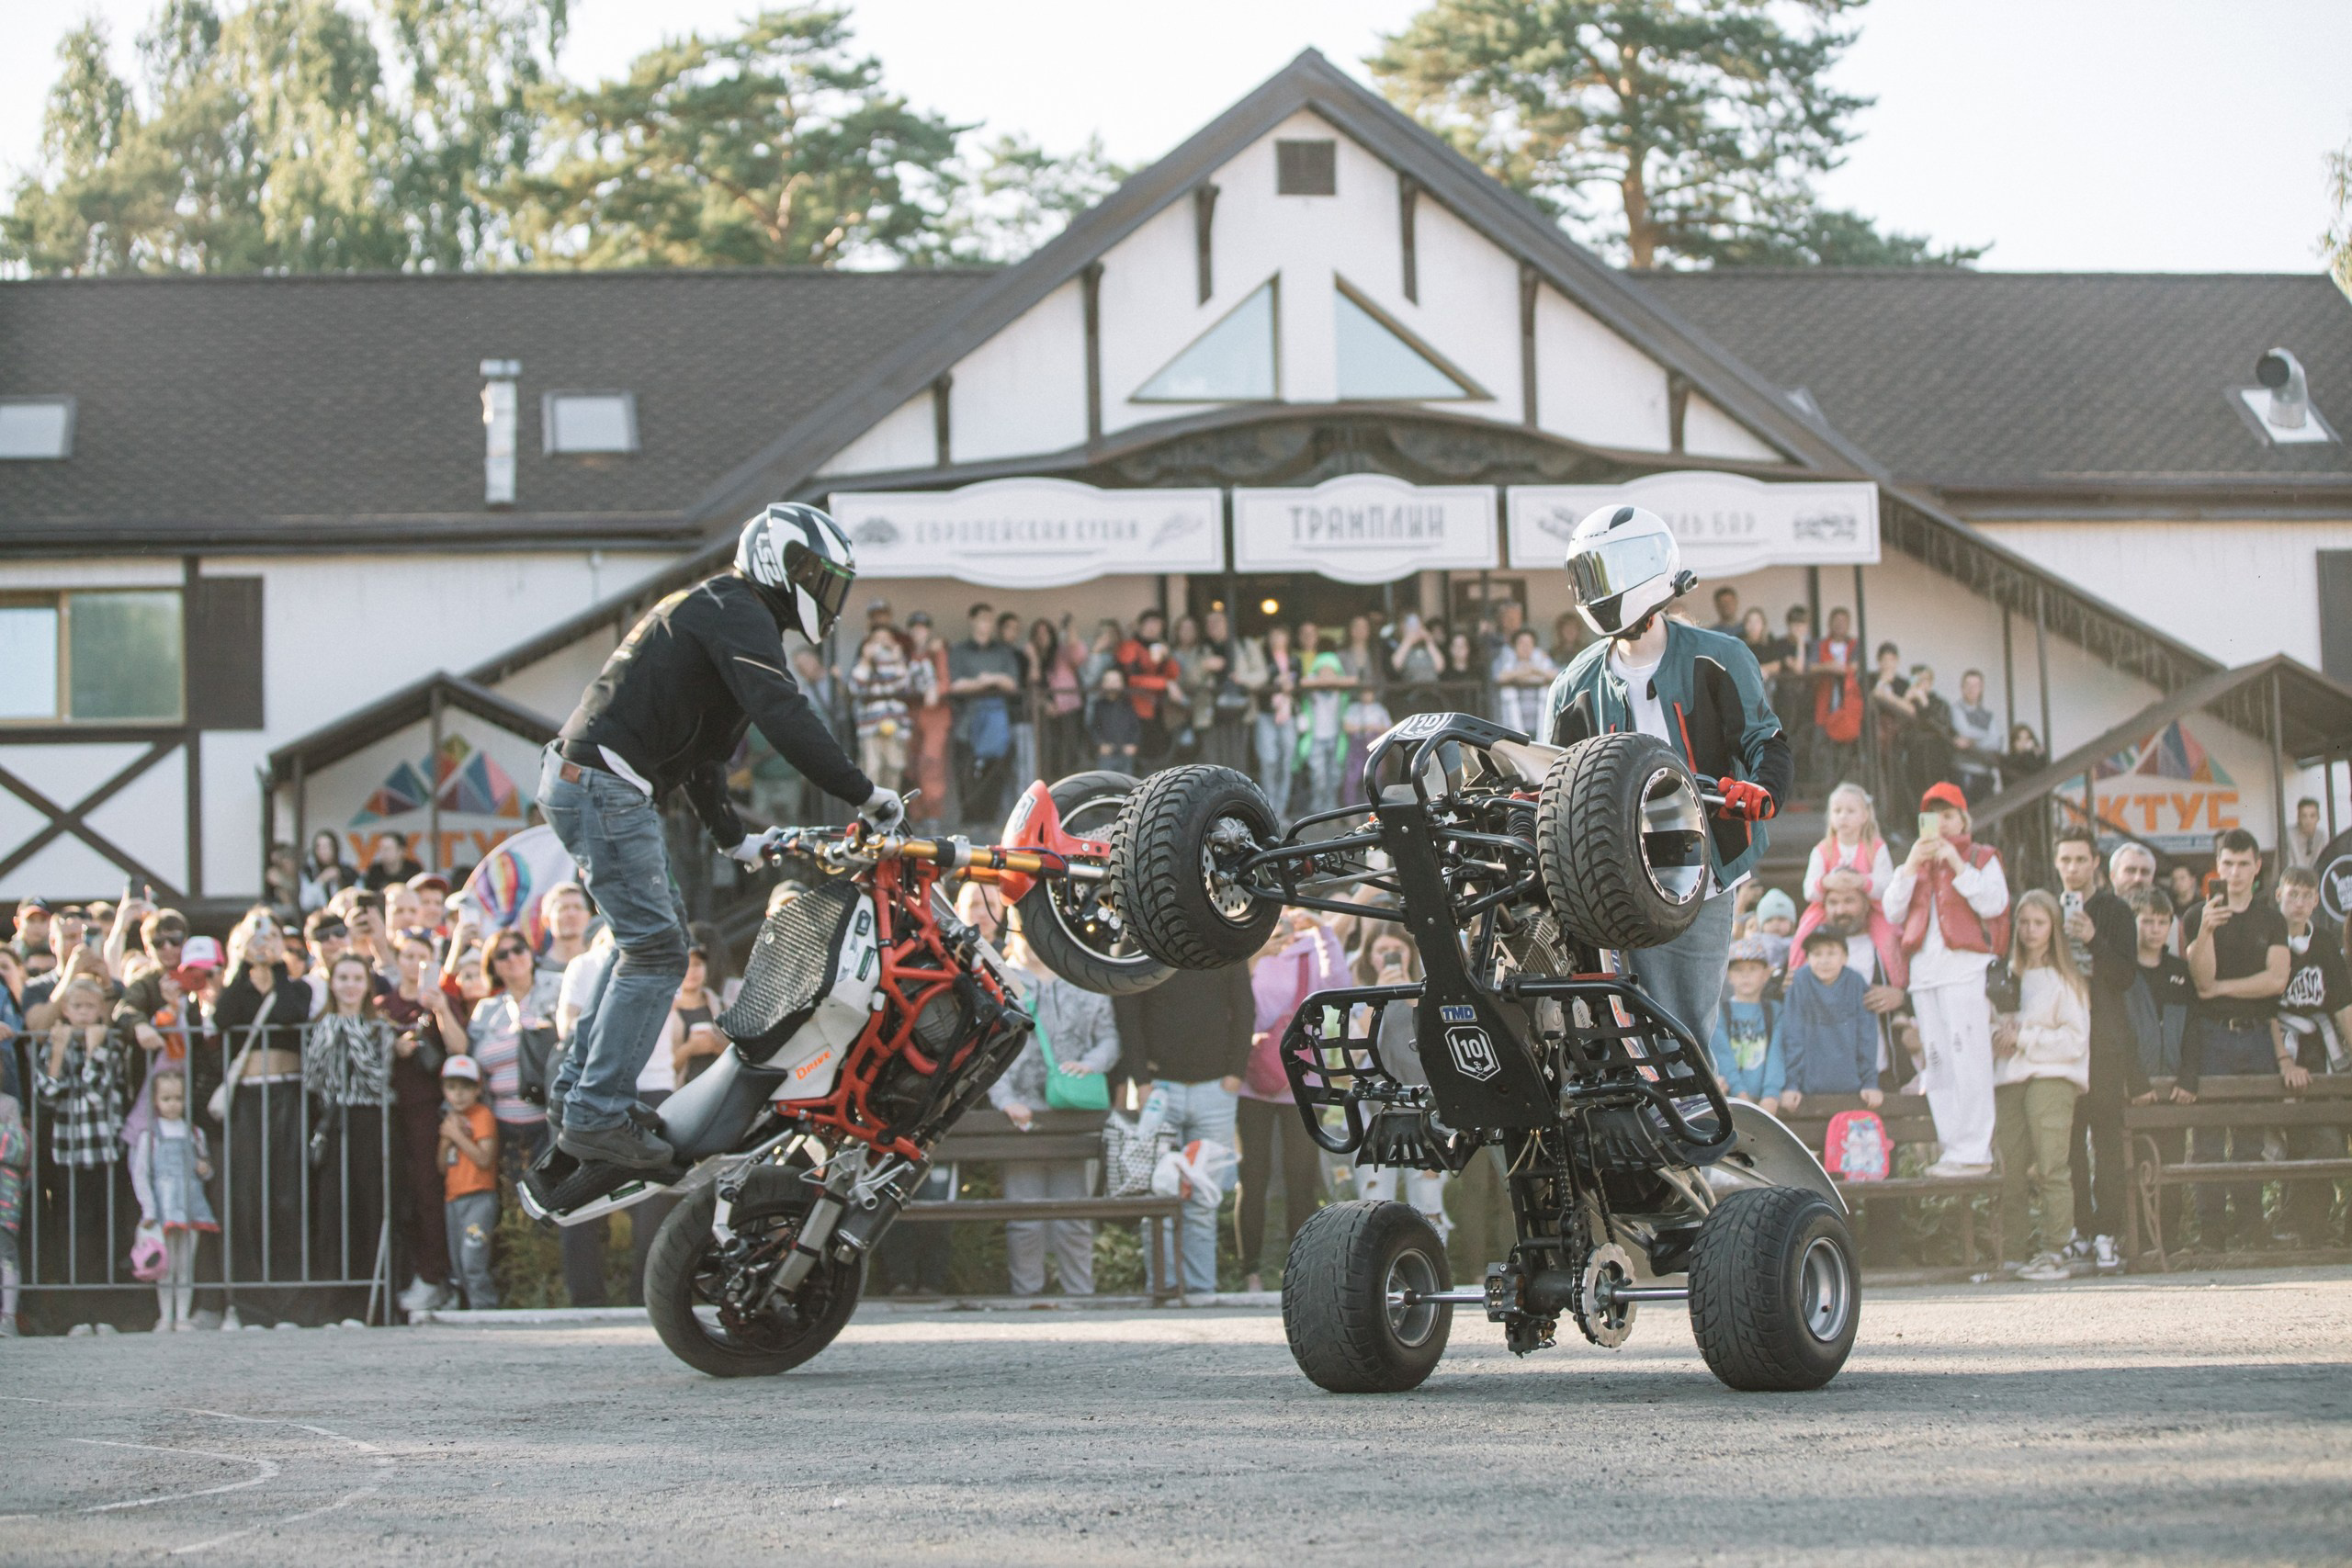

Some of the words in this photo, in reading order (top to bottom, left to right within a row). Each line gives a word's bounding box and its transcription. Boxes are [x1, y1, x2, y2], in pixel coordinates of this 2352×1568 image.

[1289, 505, 1444, 539] ТРАМПЛИН
[1417, 715, 1441, 728] 10
[1442, 1007, 1474, 1021] TMD
[1460, 1039, 1484, 1058] 10
[796, 1050, 831, 1081] DRIVE
